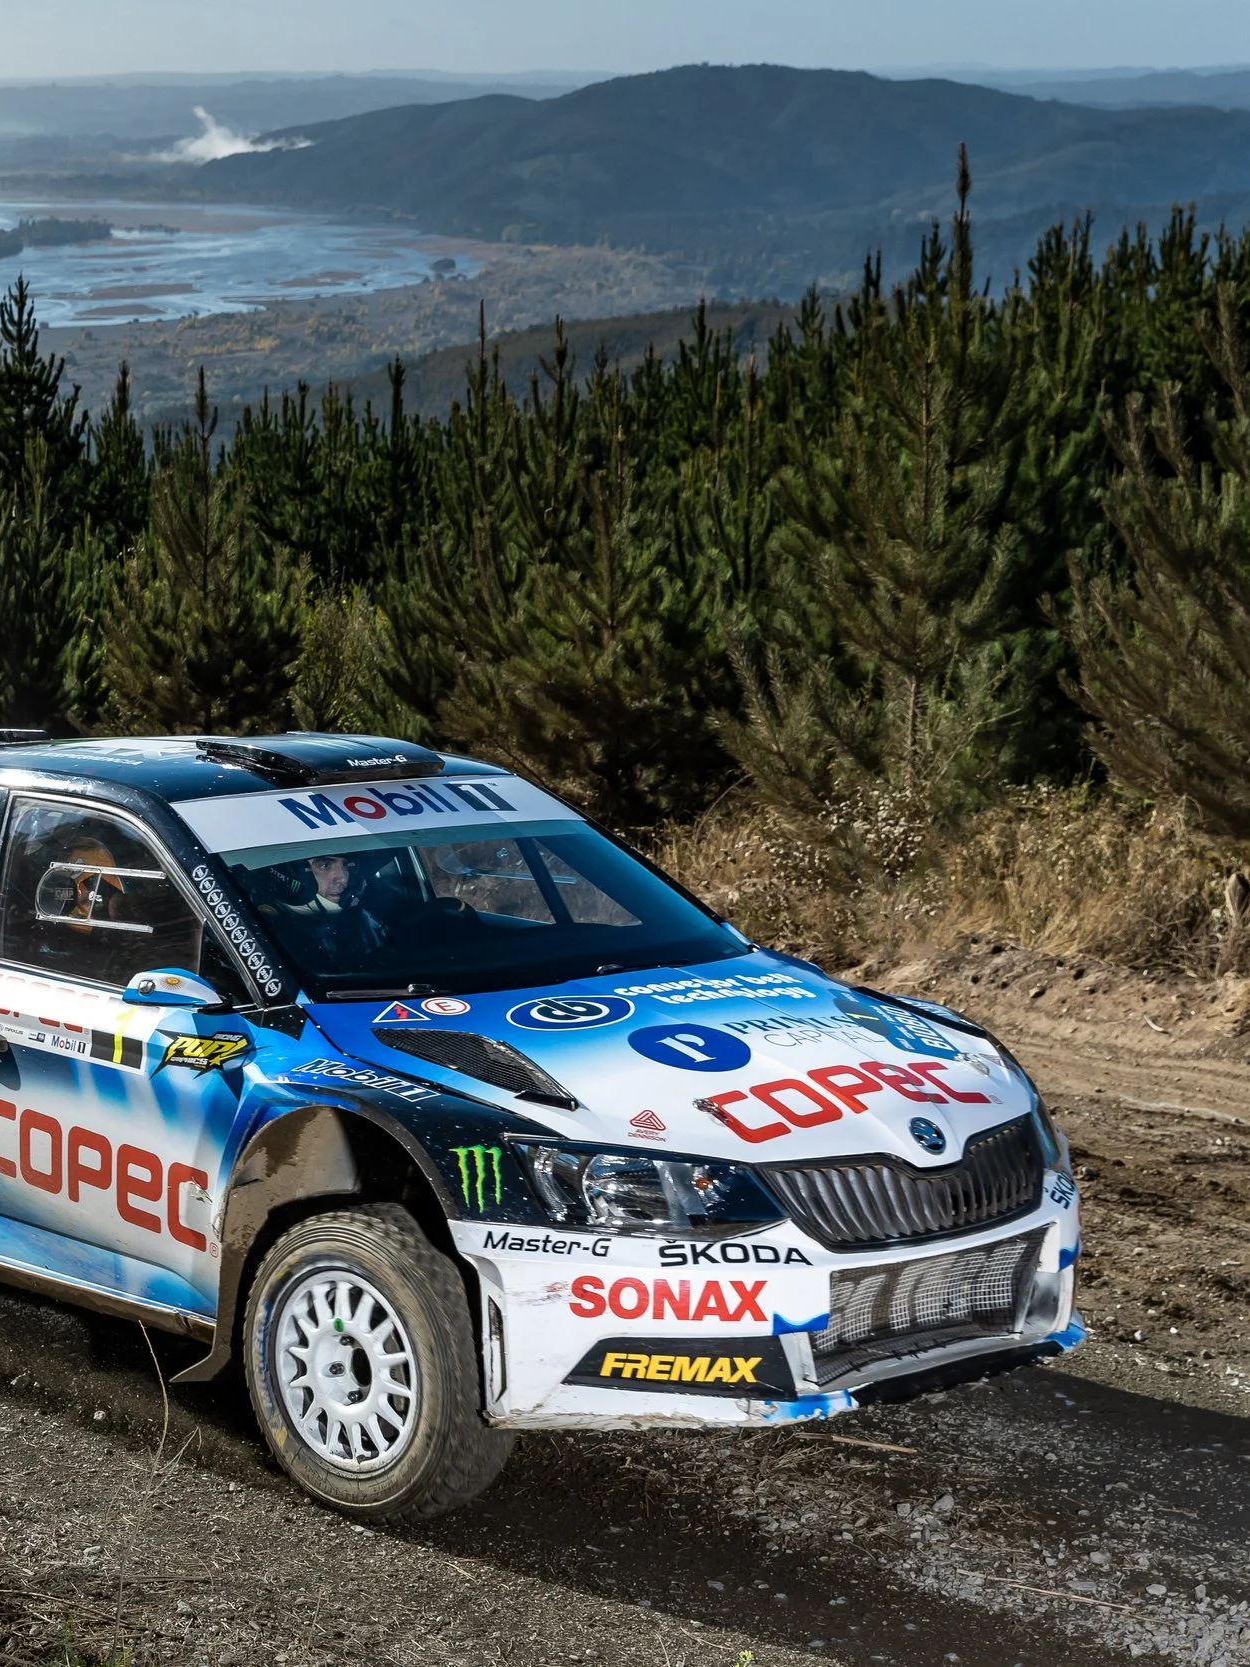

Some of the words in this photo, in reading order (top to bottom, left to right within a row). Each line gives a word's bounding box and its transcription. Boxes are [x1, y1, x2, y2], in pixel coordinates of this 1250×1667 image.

[346, 754, 408, 767] Master-G
[278, 783, 460, 830] Mobil
[613, 977, 744, 997] conveyor
[734, 973, 803, 986] belt
[652, 986, 817, 1005] technology
[720, 1014, 862, 1035] PRIMUS
[51, 1034, 77, 1052] Mobil
[763, 1030, 887, 1048] CAPITAL
[291, 1057, 410, 1089] Mobil
[483, 1230, 612, 1257] Master-G
[658, 1239, 814, 1268] ŠKODA
[569, 1275, 769, 1322] SONAX
[600, 1352, 764, 1384] FREMAX
